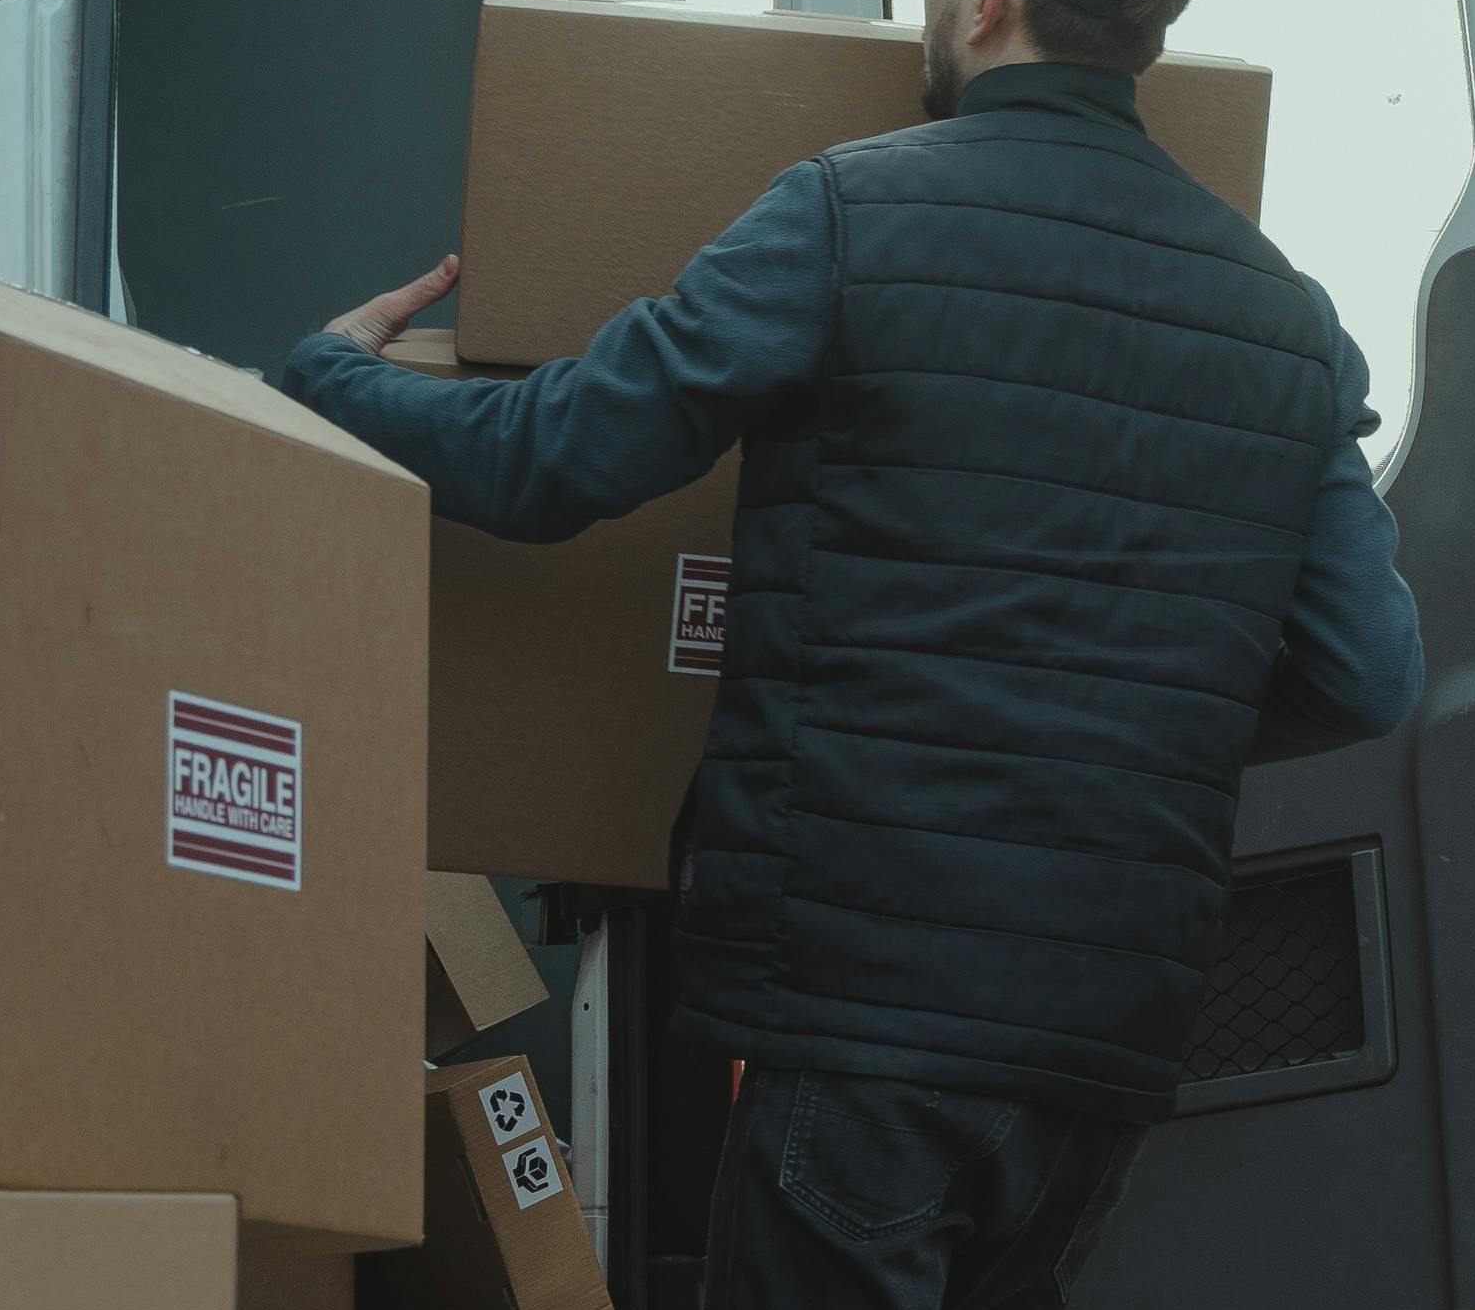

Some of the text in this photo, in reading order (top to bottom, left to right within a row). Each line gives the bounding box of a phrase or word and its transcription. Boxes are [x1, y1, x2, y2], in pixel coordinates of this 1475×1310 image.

[175, 748, 294, 816] FRAGILE
[175, 794, 294, 839] HANDLE WITH CARE
